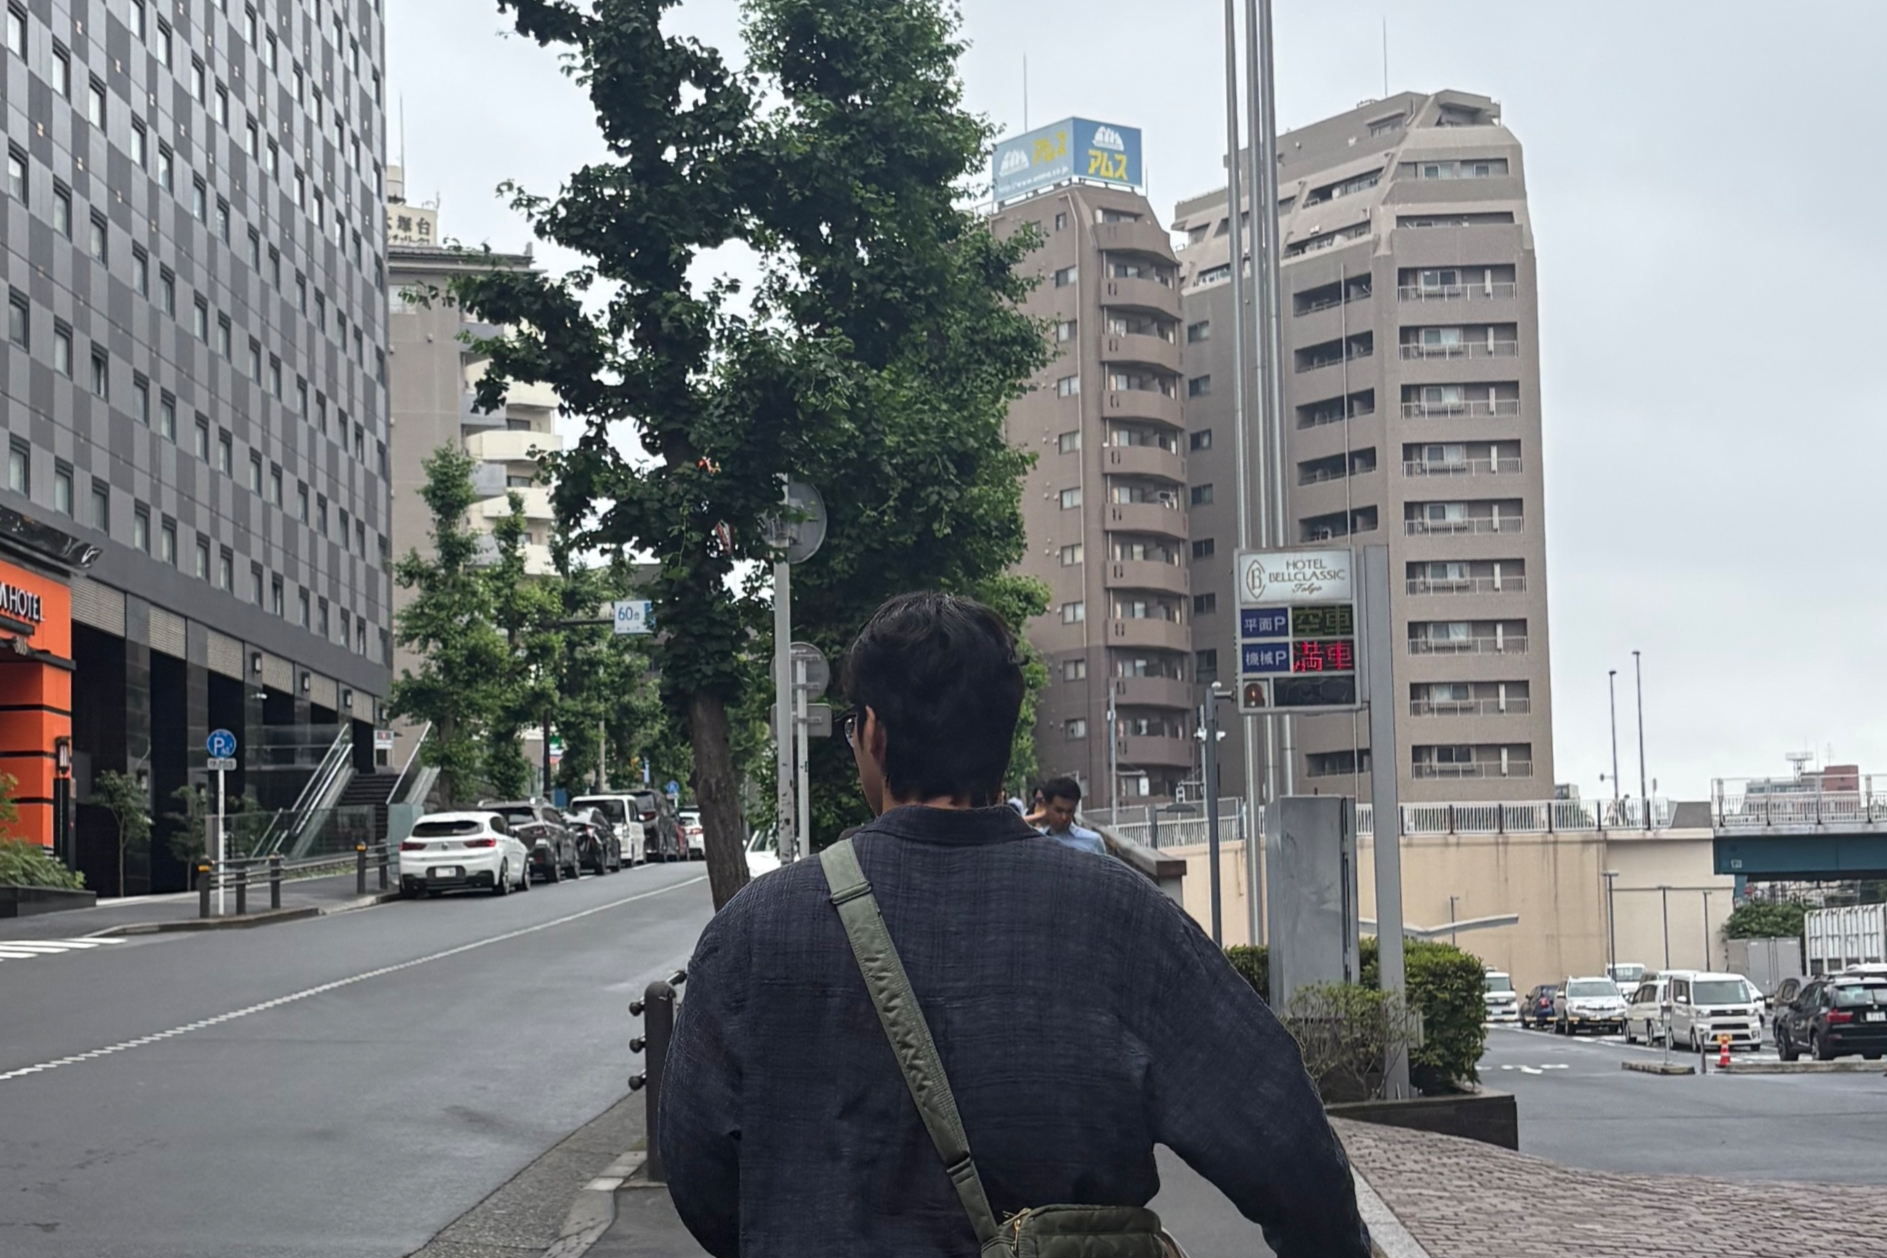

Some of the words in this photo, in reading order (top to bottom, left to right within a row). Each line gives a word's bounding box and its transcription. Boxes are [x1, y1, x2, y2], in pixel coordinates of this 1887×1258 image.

[1088, 149, 1128, 181] アムス
[1286, 559, 1326, 570] HOTEL
[1269, 569, 1345, 583] BELLCLASSIC
[9, 585, 46, 622] HOTEL
[1244, 617, 1286, 632] 平面P
[1246, 651, 1287, 667] 機械P
[1293, 640, 1352, 673] 満車
